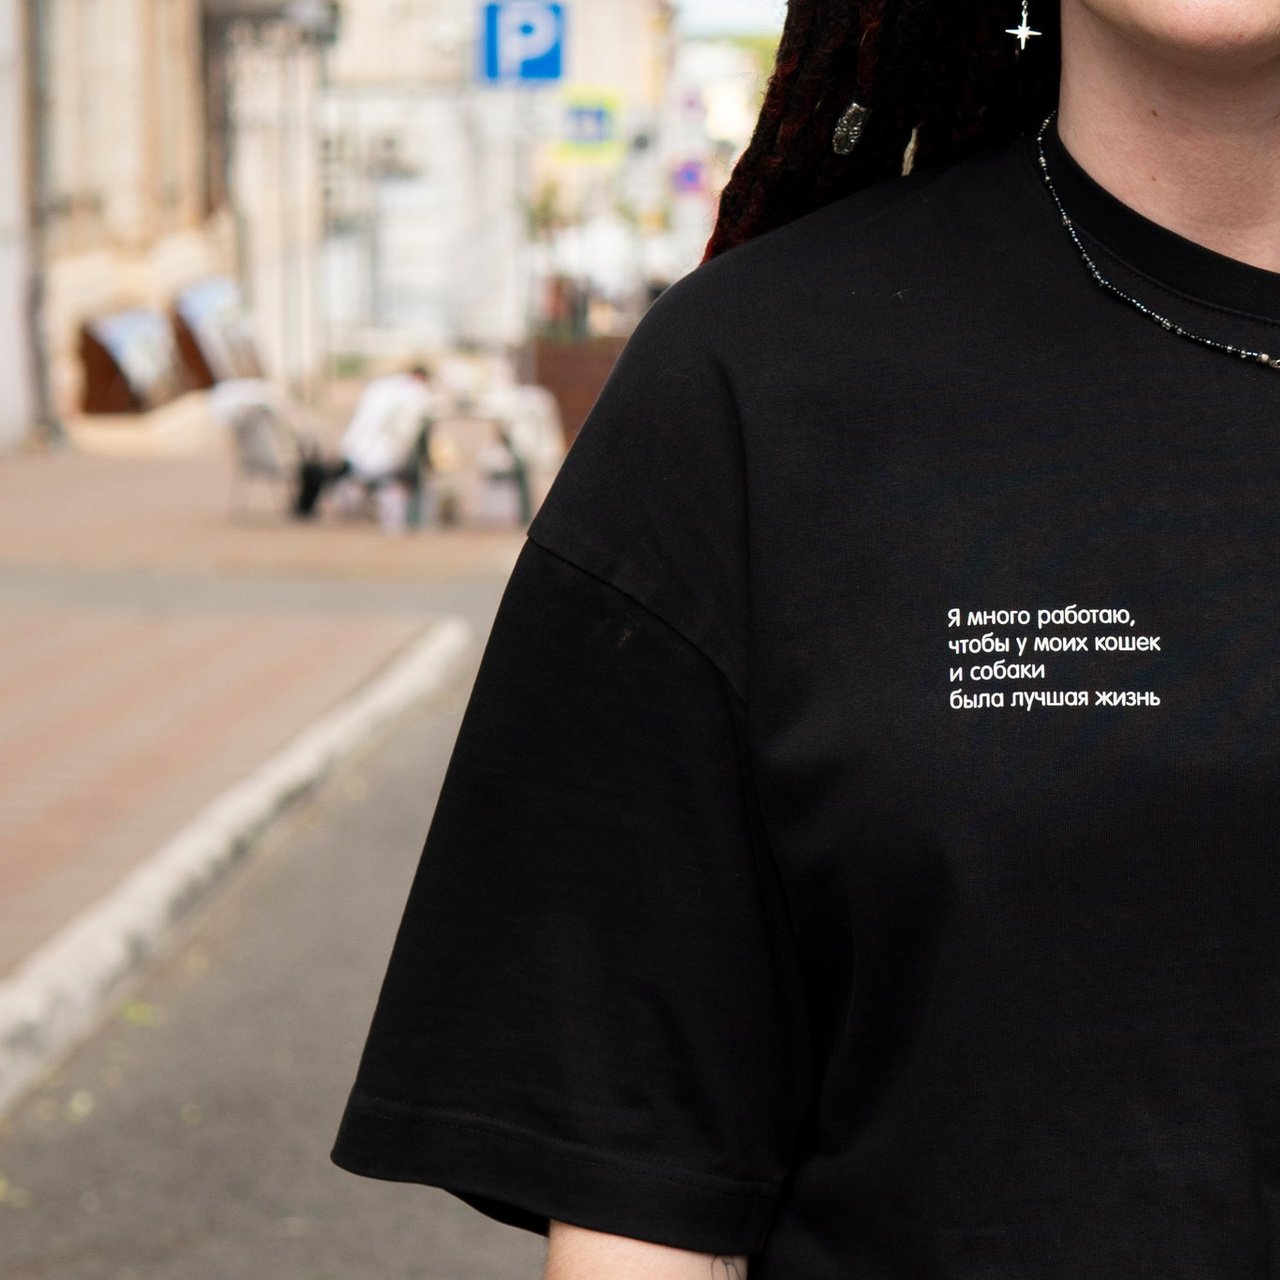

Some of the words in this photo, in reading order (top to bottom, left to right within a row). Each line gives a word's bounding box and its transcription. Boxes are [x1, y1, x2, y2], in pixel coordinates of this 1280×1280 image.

[947, 608, 960, 627] Я
[967, 609, 1031, 626] много
[1037, 604, 1136, 629] работаю,
[948, 632, 1010, 654] чтобы
[1016, 637, 1027, 656] у
[1033, 636, 1089, 651] моих
[1095, 636, 1161, 651] кошек
[950, 667, 963, 682] и
[970, 659, 1045, 680] собаки
[950, 688, 1004, 709] была
[1011, 691, 1089, 711] лучшая
[1095, 691, 1161, 706] жизнь
